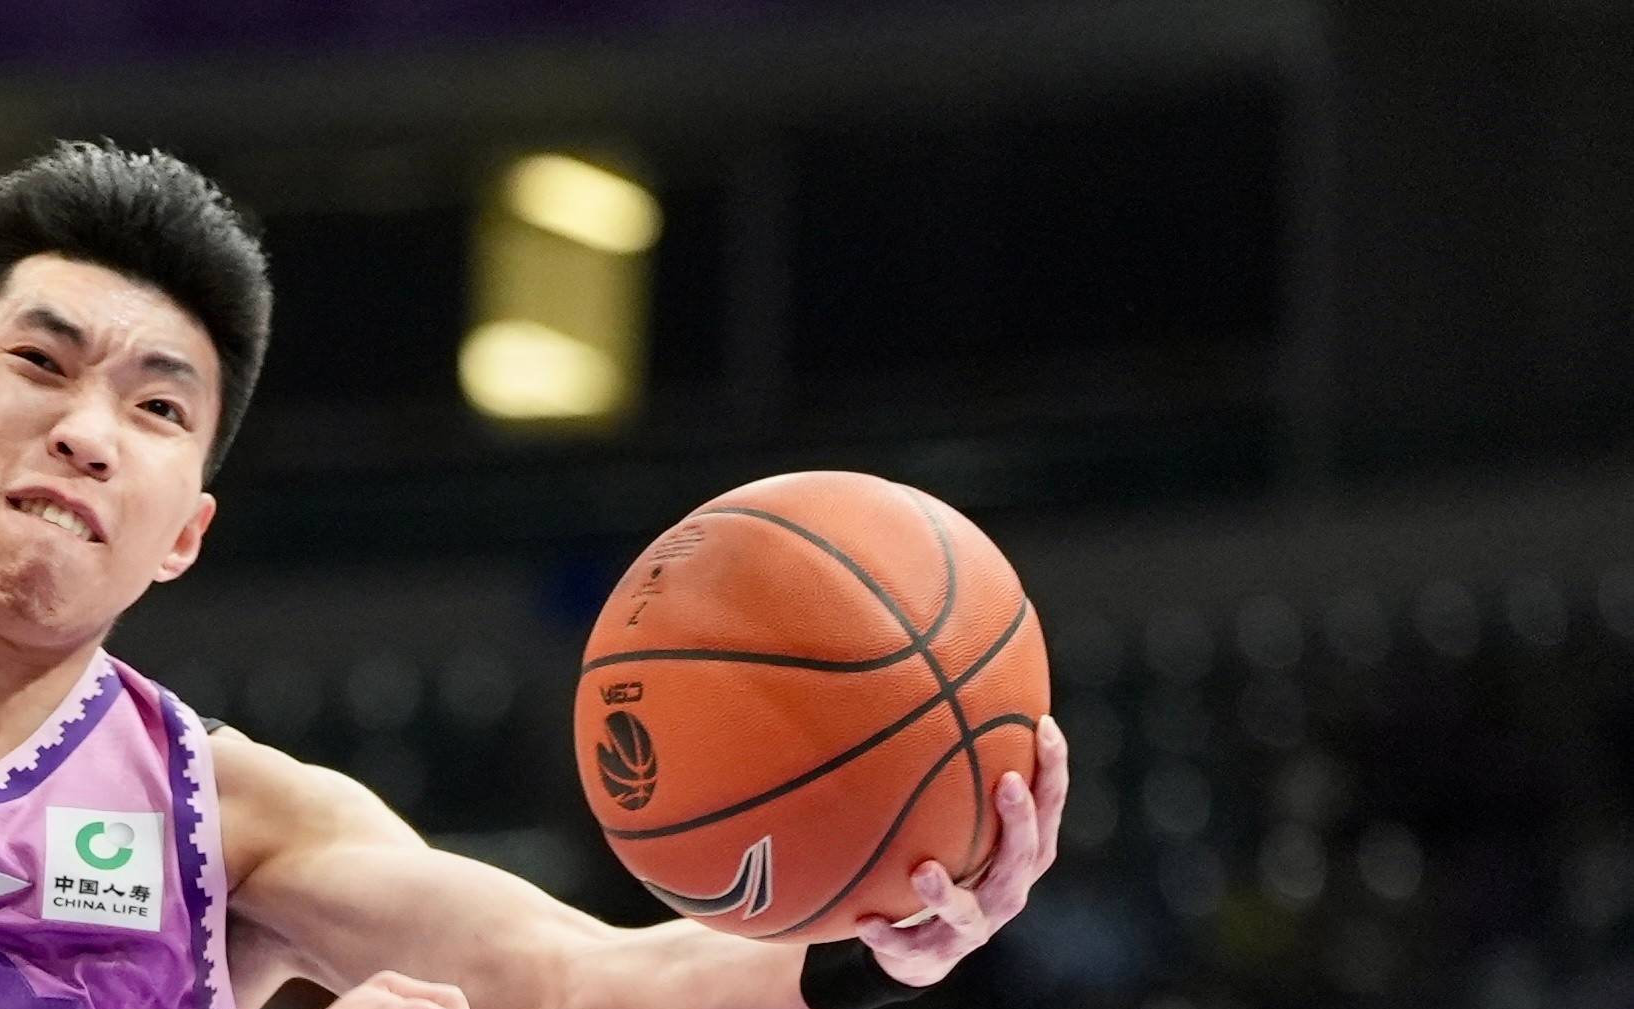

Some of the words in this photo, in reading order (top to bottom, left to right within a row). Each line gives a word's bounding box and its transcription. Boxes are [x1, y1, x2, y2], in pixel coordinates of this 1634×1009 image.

[54, 875, 150, 903] 中国人寿
[53, 897, 106, 912] CHINA
[113, 904, 148, 917] LIFE
